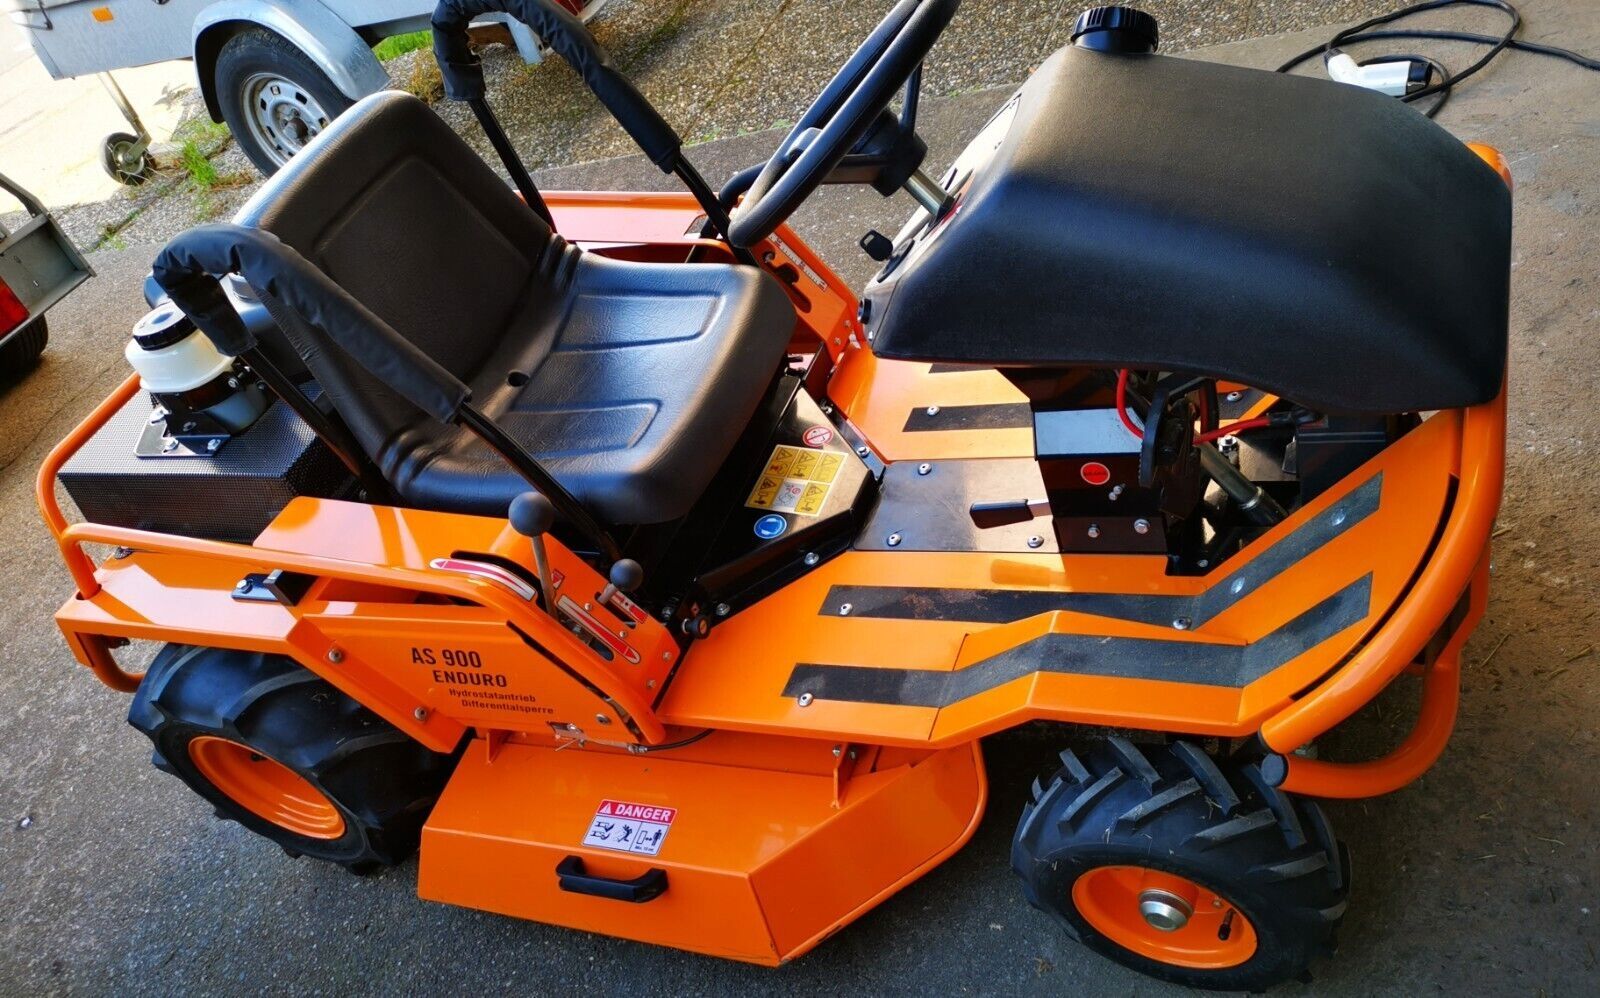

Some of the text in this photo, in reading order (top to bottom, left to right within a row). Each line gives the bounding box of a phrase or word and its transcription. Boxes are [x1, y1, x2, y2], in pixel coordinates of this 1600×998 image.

[411, 647, 482, 668] AS 900
[432, 669, 507, 687] ENDURO
[449, 688, 536, 703] Hydrostatantrieb
[461, 699, 554, 714] Differentialsperre
[615, 804, 671, 821] DANGER
